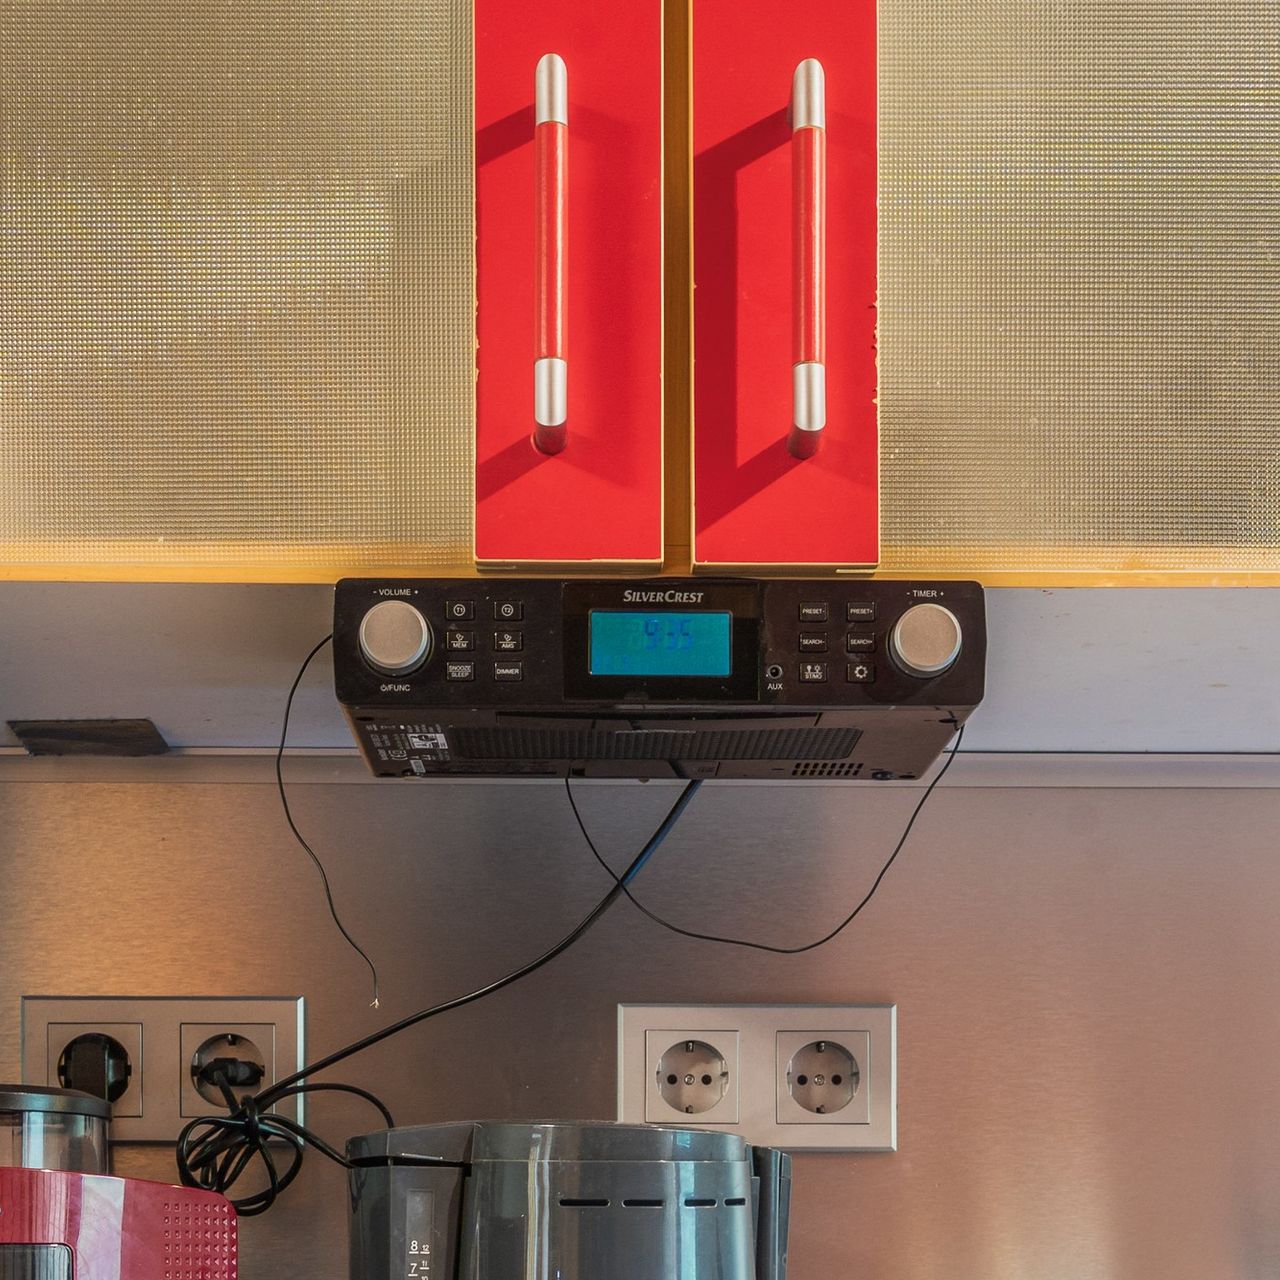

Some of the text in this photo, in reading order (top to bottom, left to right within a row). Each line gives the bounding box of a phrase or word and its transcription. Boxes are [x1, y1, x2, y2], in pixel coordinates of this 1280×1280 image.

[378, 588, 411, 596] VOLUME
[912, 589, 938, 598] TIMER
[410, 1240, 418, 1252] 8
[410, 1262, 418, 1274] 7
